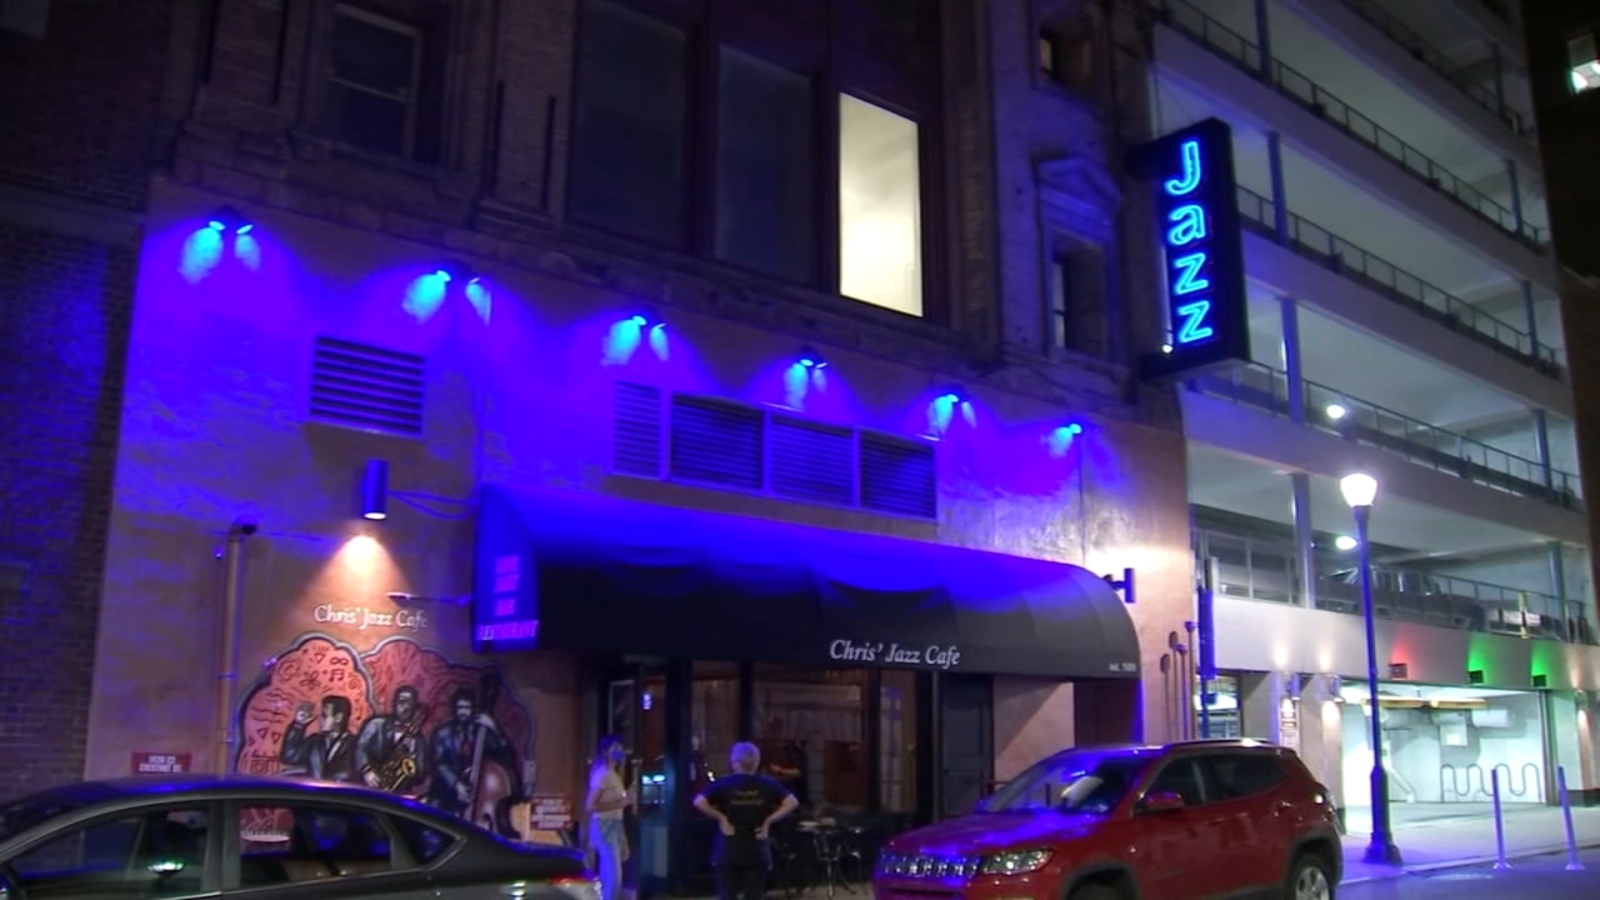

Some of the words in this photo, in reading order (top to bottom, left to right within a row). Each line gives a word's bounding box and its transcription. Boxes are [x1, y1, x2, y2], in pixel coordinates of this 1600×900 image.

[1164, 140, 1214, 343] Jazz
[313, 603, 361, 624] Chris'
[358, 607, 393, 630] Jazz
[395, 609, 428, 632] Cafe
[829, 639, 884, 661] Chris'
[884, 643, 921, 664] Jazz
[924, 645, 961, 670] Cafe
